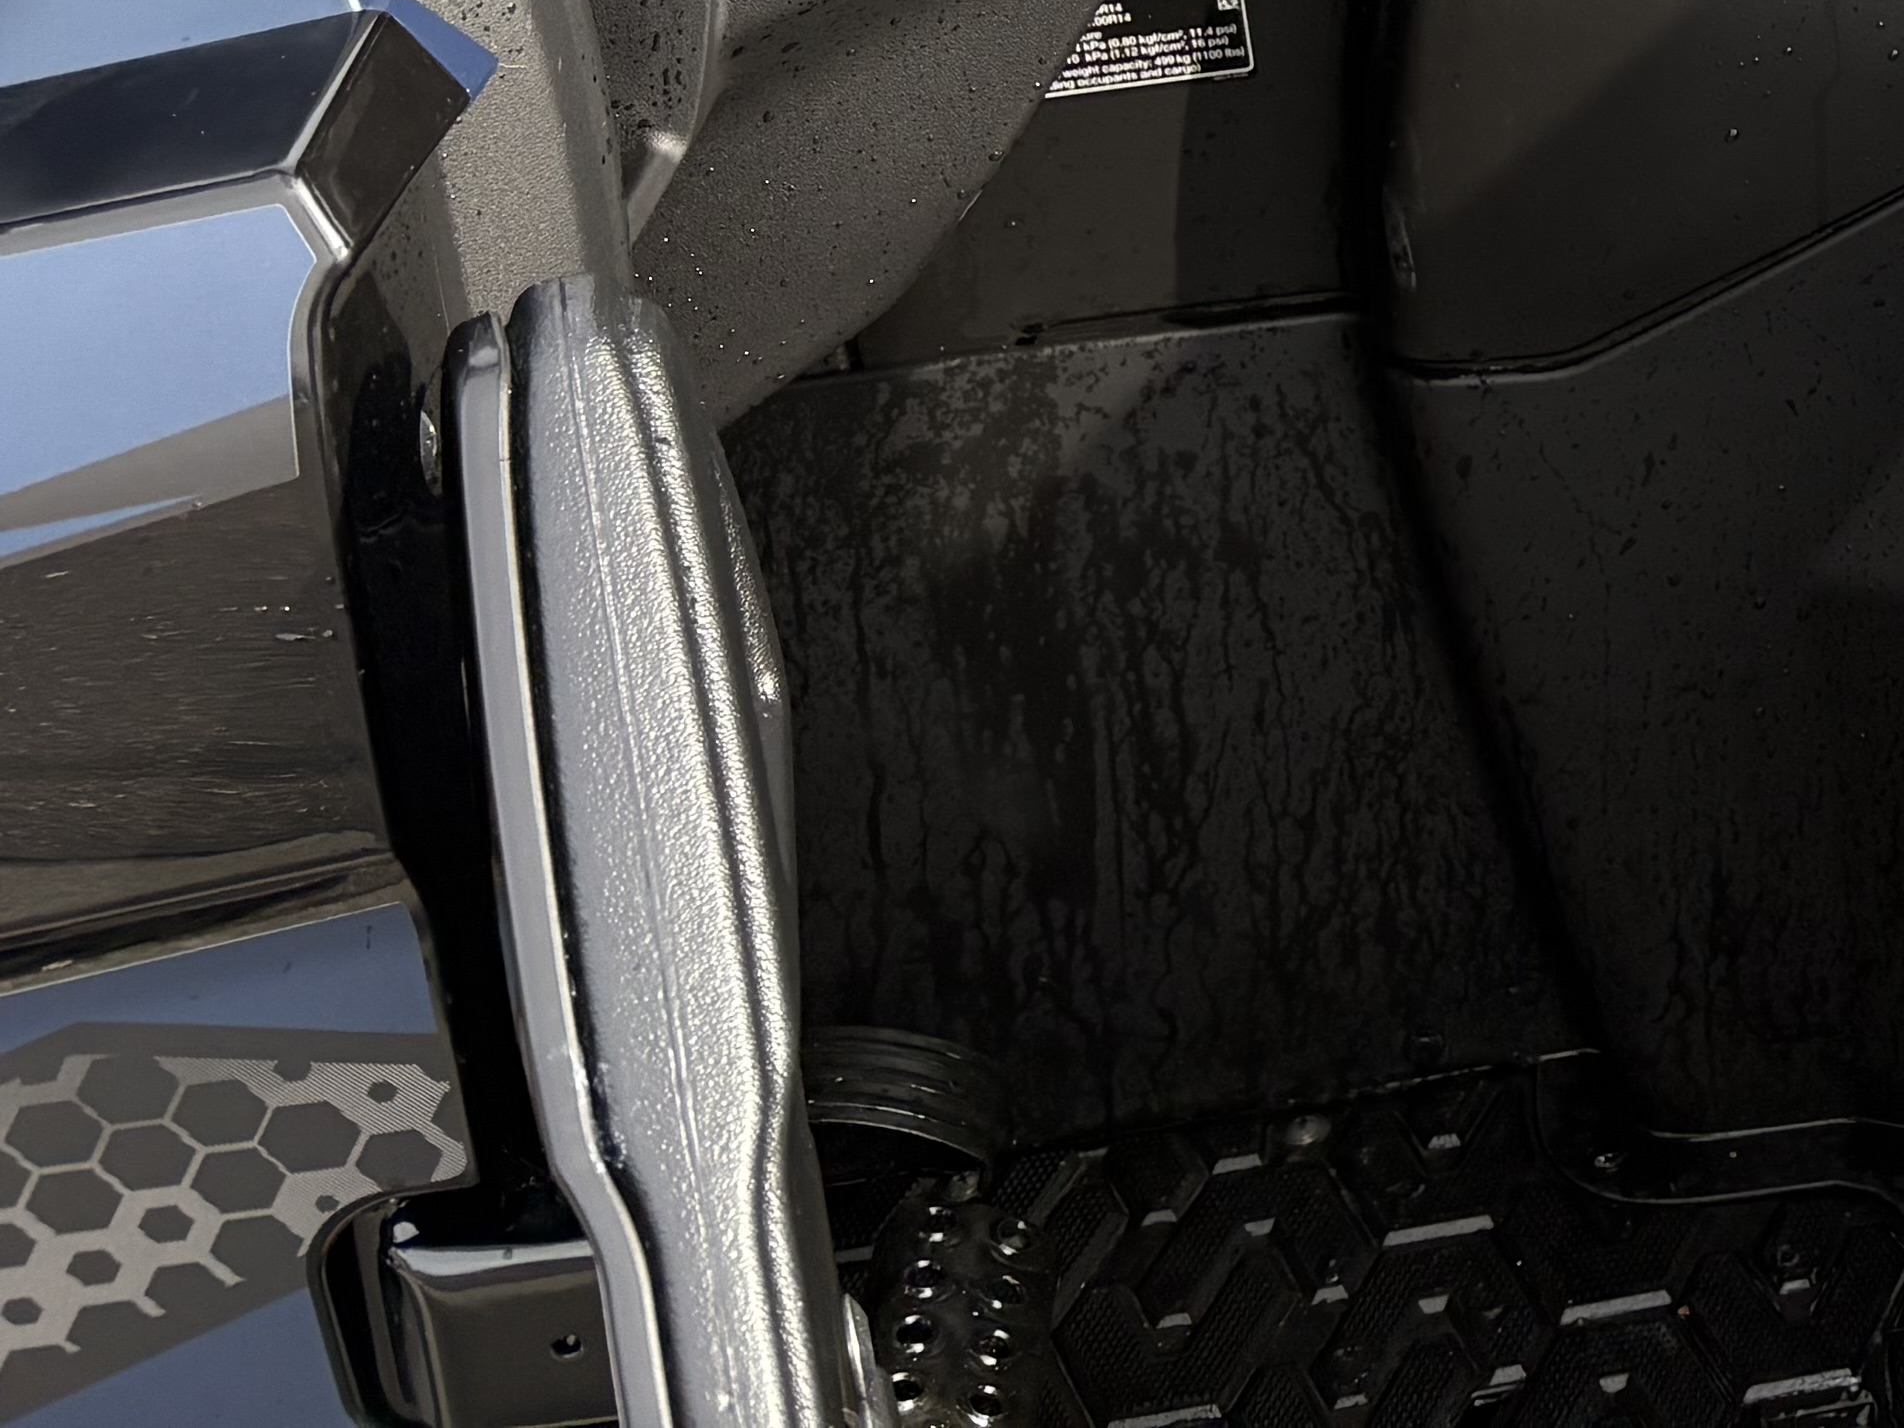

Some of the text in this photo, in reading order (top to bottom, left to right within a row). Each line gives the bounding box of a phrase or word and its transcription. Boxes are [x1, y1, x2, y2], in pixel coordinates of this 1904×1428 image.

[1082, 40, 1107, 52] kPa
[1215, 22, 1237, 37] psi)
[1084, 50, 1109, 63] kPa
[1109, 46, 1139, 61] (1.12
[1191, 37, 1206, 49] 16
[1207, 34, 1230, 48] psi)
[1061, 64, 1100, 79] weight
[1101, 58, 1154, 74] capacity:
[1175, 53, 1192, 66] kg
[1076, 70, 1139, 88] occupants
[1140, 67, 1163, 80] and
